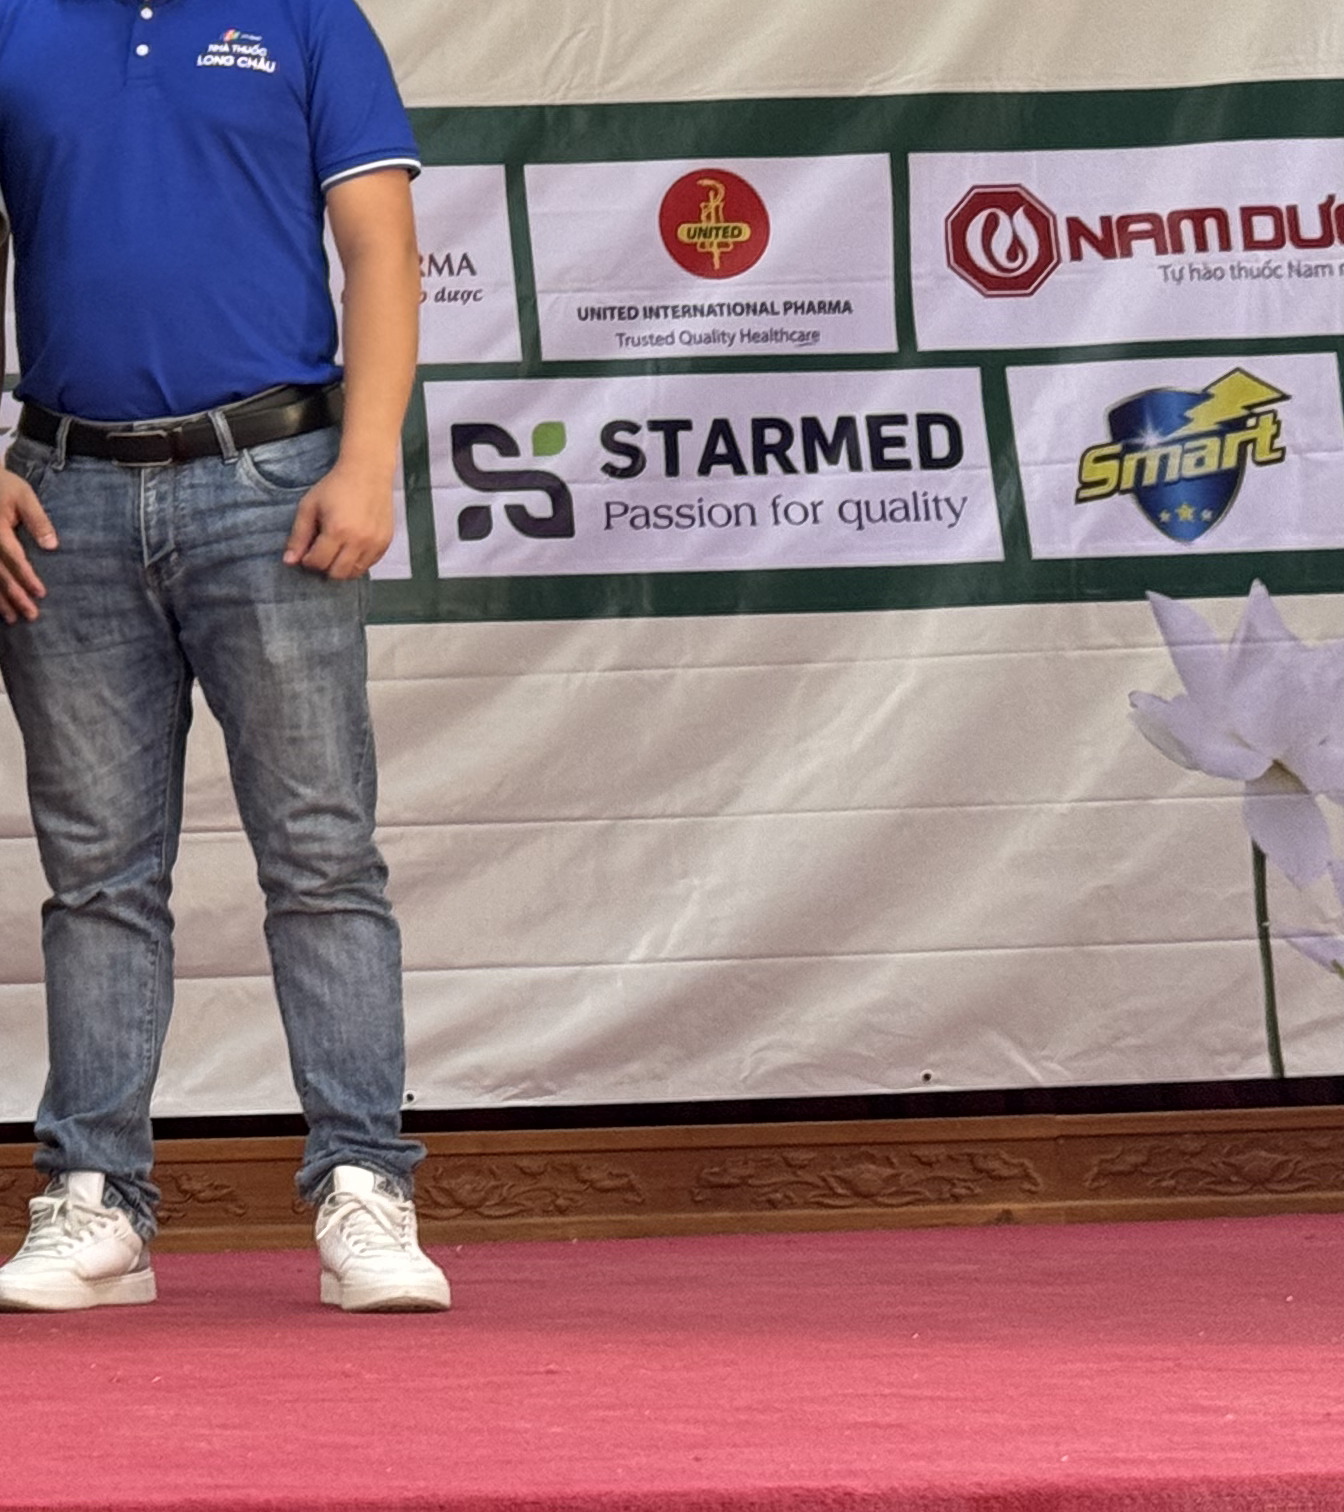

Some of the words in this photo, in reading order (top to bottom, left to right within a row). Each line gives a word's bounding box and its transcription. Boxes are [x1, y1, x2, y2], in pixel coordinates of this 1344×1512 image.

[196, 54, 235, 67] LONG
[686, 224, 743, 241] UNITED
[1065, 207, 1233, 262] NAM
[1239, 193, 1344, 252] DƯ
[1188, 262, 1226, 282] hào
[1229, 259, 1283, 280] thuốc
[1287, 261, 1334, 278] Nam
[577, 304, 640, 322] UNITED
[643, 300, 780, 320] INTERNATIONAL
[783, 300, 854, 316] PHARMA
[615, 331, 676, 348] Trusted
[678, 329, 738, 348] Quality
[739, 327, 820, 345] Healthcare
[599, 411, 965, 480] STARMED
[603, 495, 758, 532] Passion
[771, 494, 824, 527] for
[837, 490, 969, 536] quality
